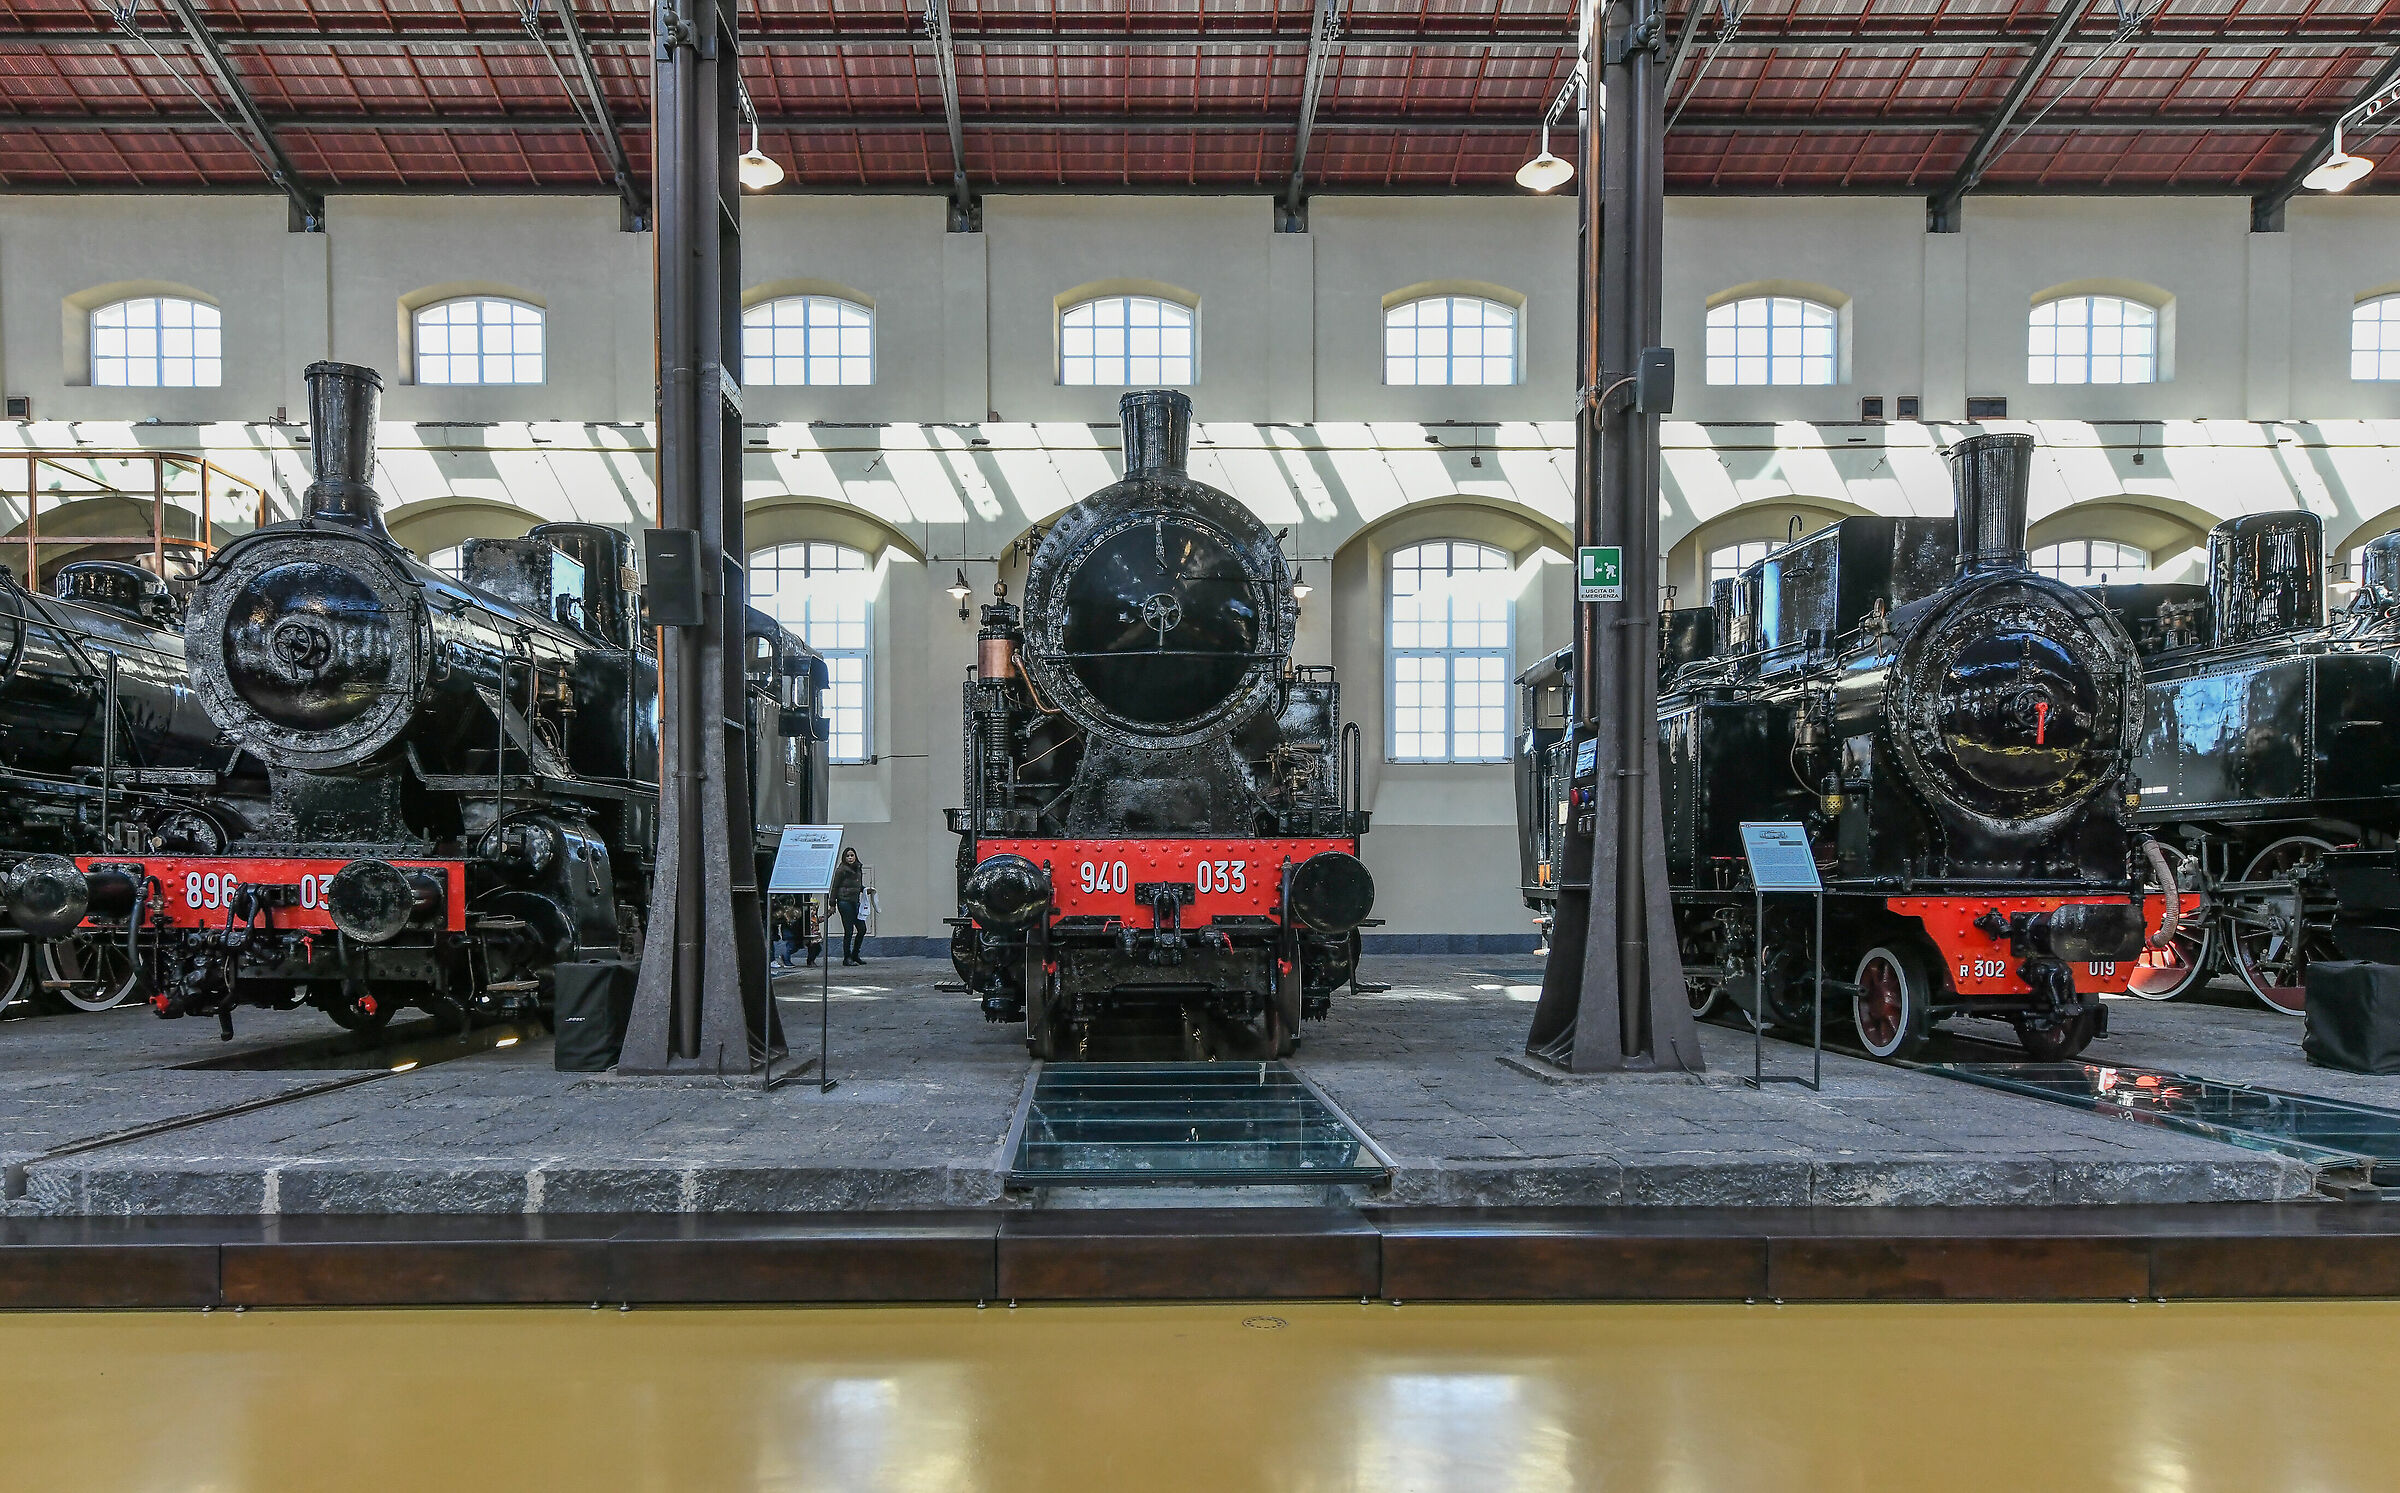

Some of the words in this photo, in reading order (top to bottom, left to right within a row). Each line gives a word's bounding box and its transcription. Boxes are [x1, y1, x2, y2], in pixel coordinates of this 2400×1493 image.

[186, 871, 239, 909] 896
[1080, 860, 1129, 894] 940
[1197, 860, 1247, 894] 033
[1959, 964, 1969, 977] R
[1974, 959, 2006, 978] 302
[2088, 961, 2116, 976] 019
